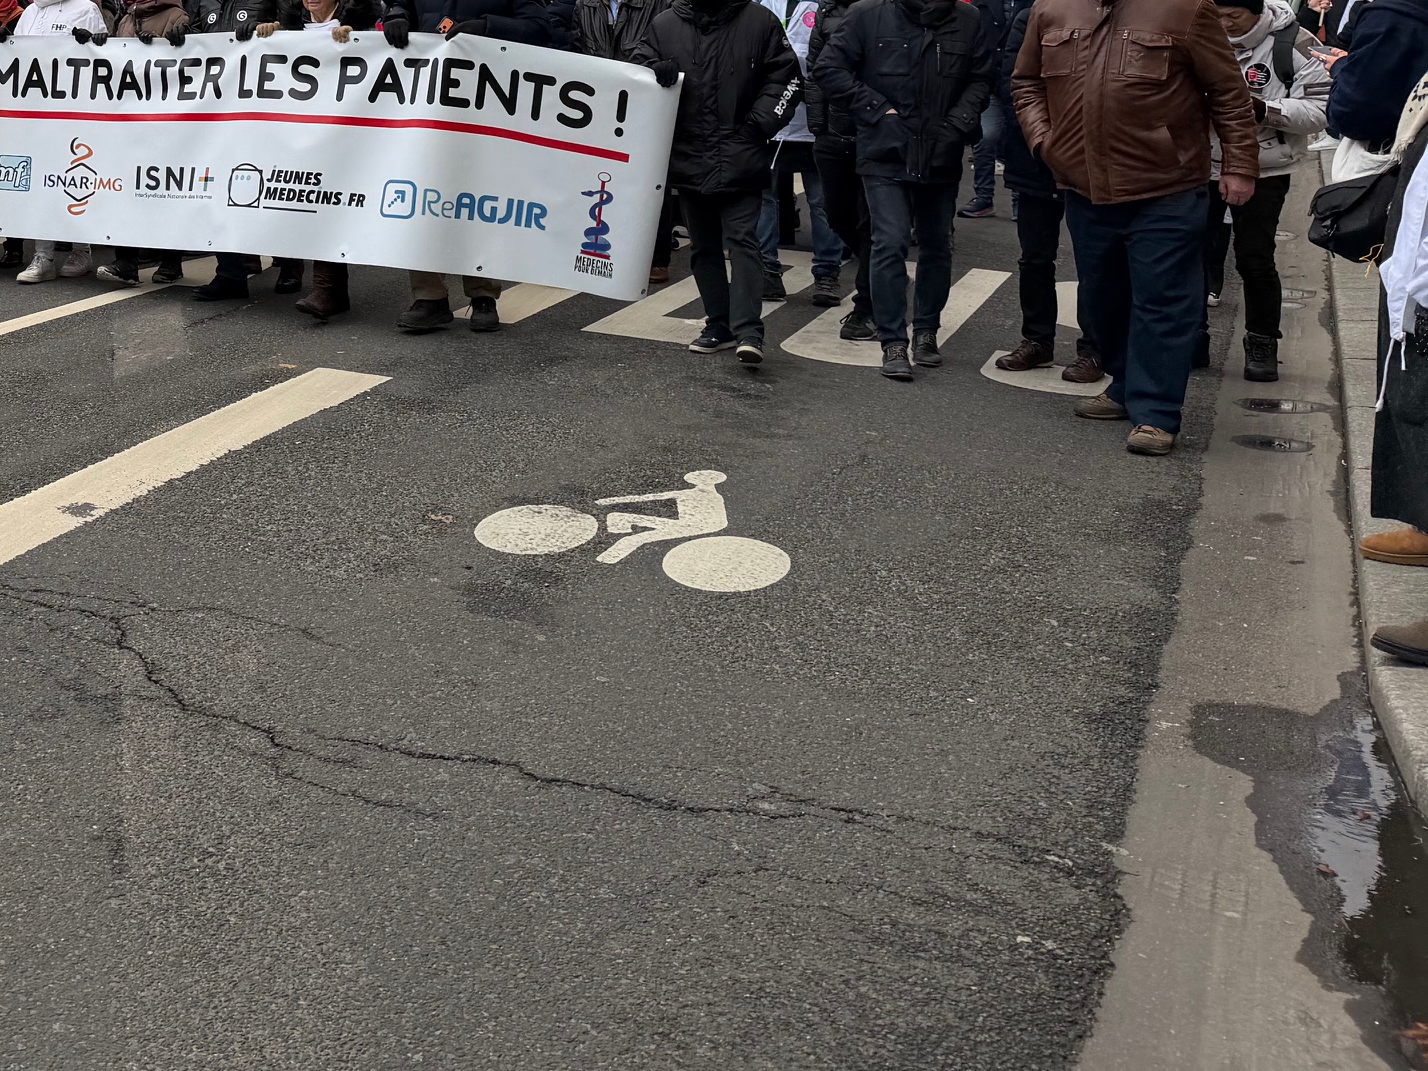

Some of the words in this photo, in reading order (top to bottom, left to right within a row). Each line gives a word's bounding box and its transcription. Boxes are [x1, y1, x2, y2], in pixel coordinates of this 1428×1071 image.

[237, 54, 321, 101] LES
[336, 56, 595, 128] PATIENTS
[614, 89, 629, 137] !
[266, 165, 323, 186] JEUNES
[264, 187, 366, 208] MEDECINS.FR
[422, 187, 547, 231] ReAGJIR
[575, 255, 614, 272] MEDECINS
